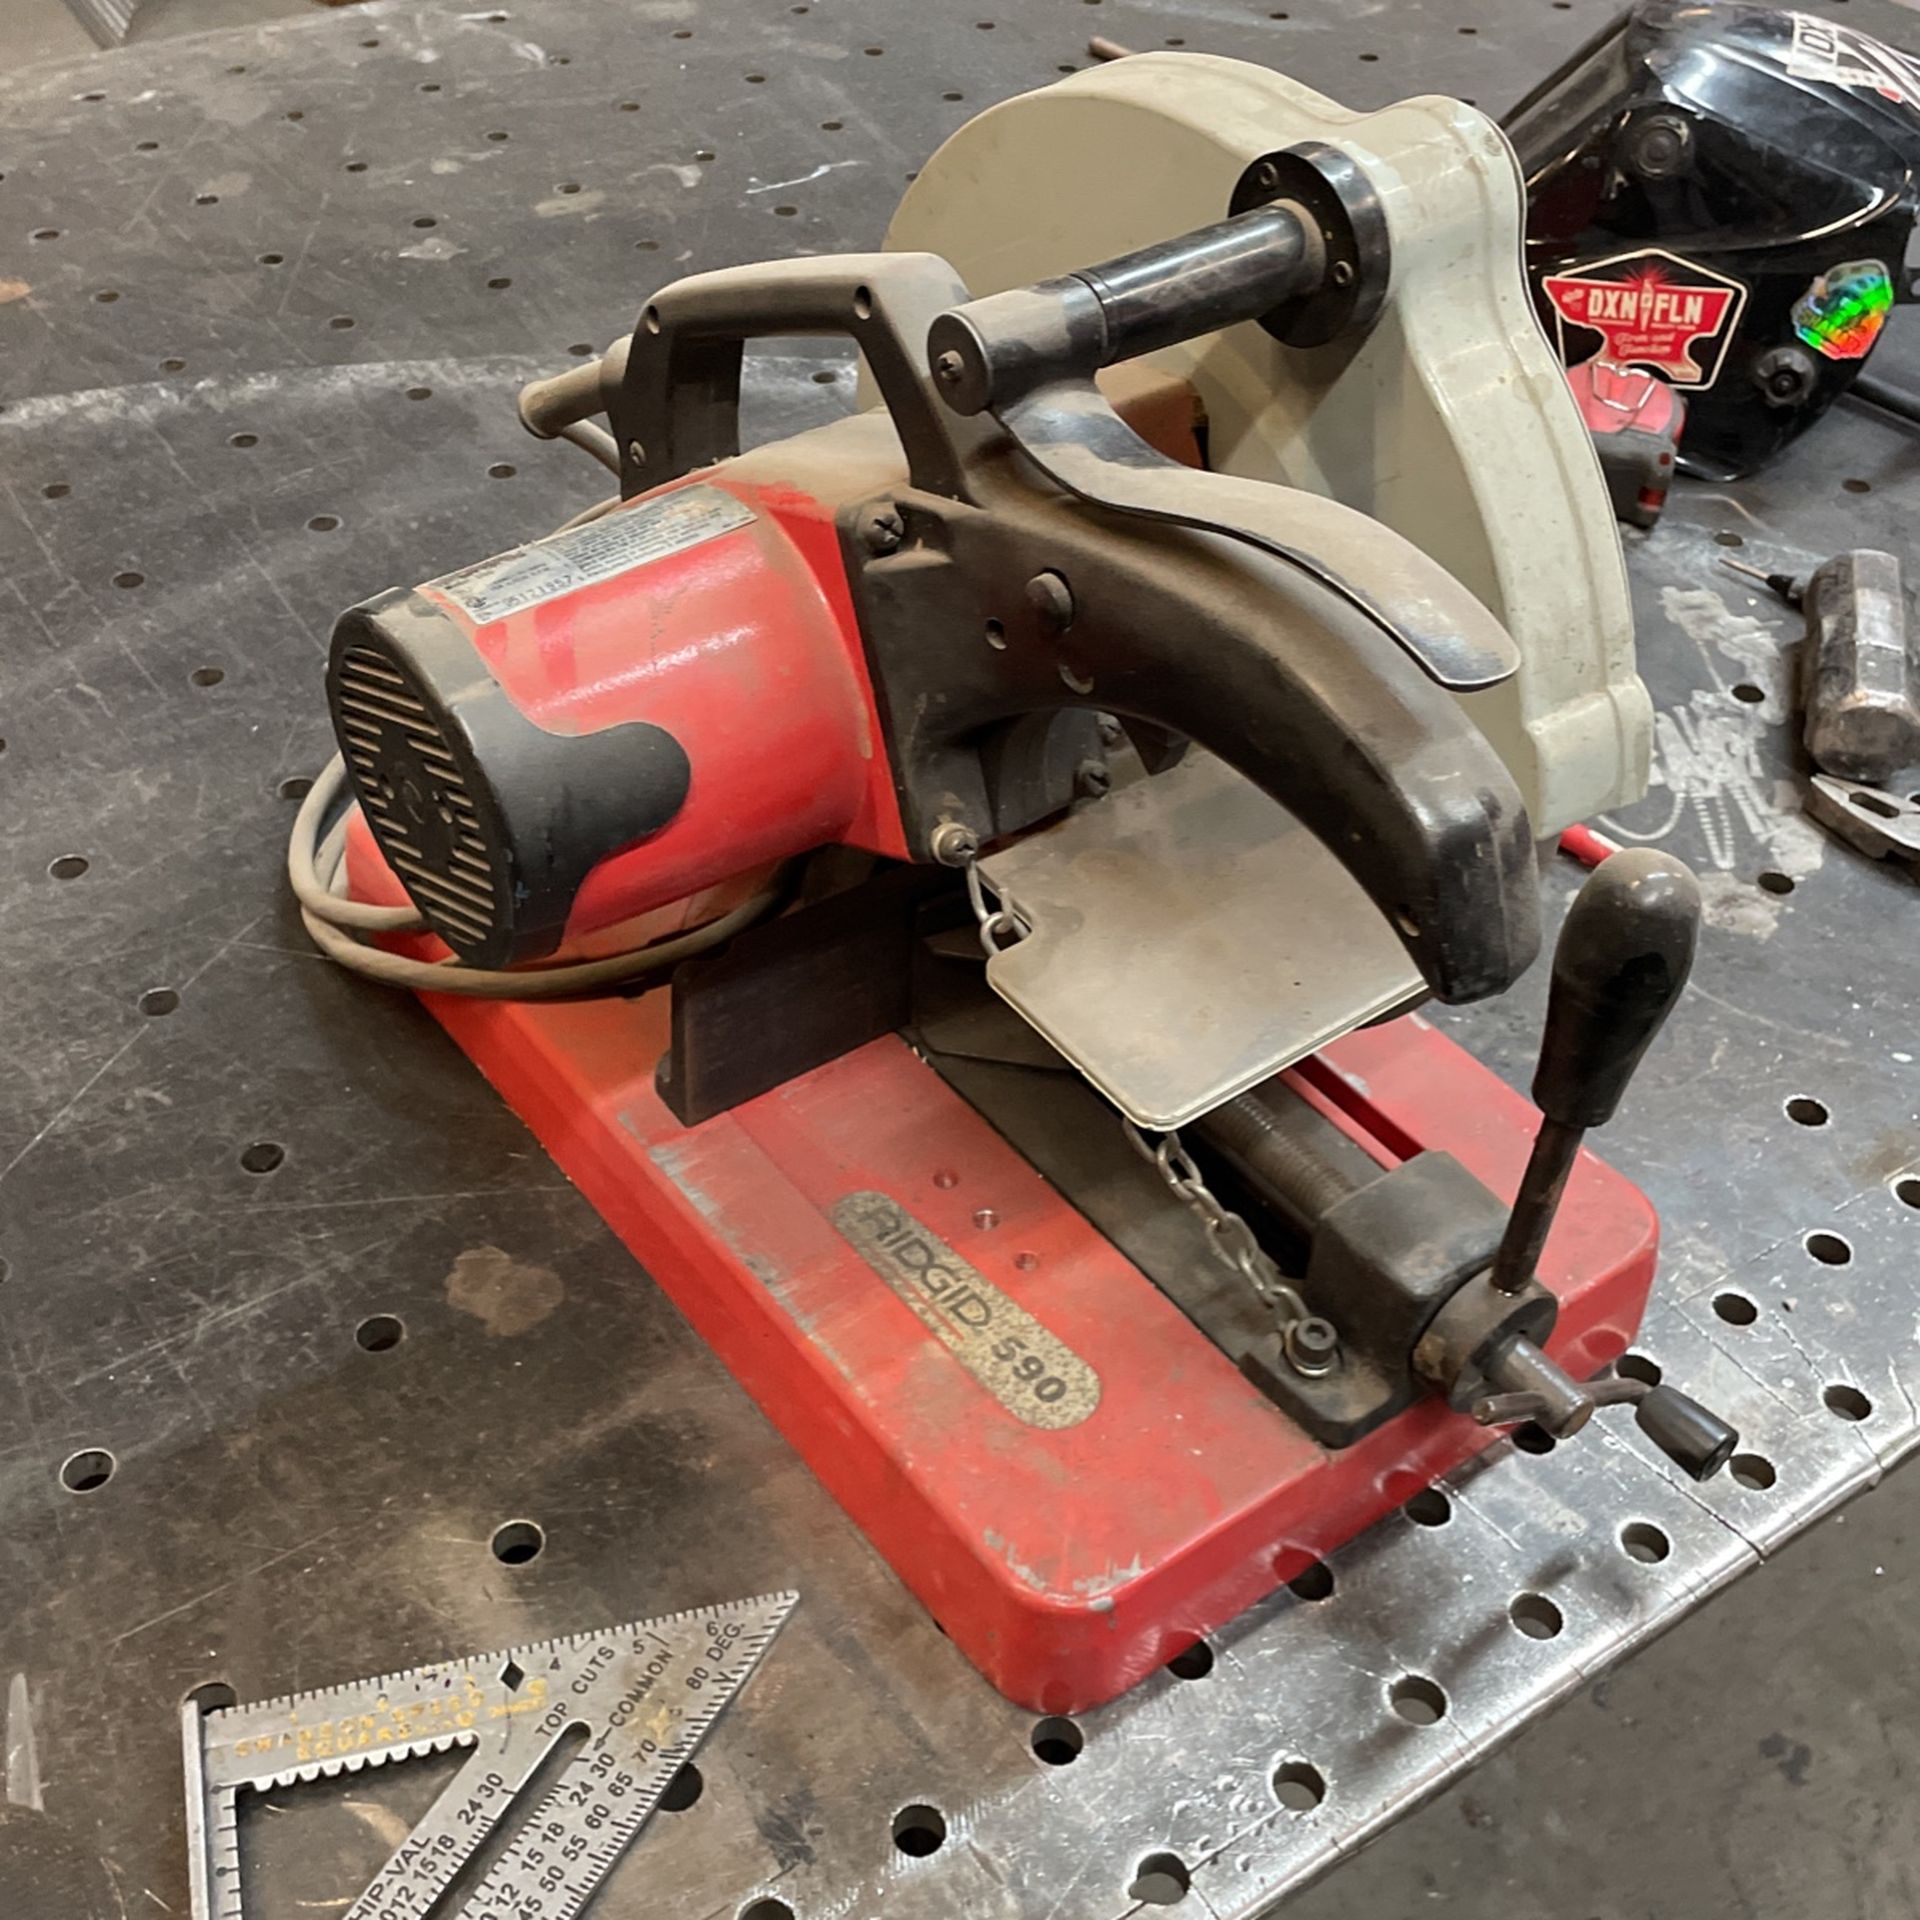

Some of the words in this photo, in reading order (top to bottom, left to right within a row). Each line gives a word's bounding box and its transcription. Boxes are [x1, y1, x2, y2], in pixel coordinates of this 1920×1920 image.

[857, 1205, 994, 1328] RIDGID
[991, 1336, 1067, 1404] 590
[535, 1702, 568, 1737] TOP
[571, 1646, 615, 1695] CUTS
[608, 1649, 674, 1728] COMMON
[632, 1638, 645, 1655] 5
[706, 1621, 719, 1637] 6
[390, 1885, 416, 1909] 12
[413, 1857, 437, 1880] 15
[432, 1833, 456, 1857] 18
[457, 1798, 483, 1825] 24
[477, 1772, 503, 1799] 30
[495, 1883, 520, 1906] 12
[521, 1847, 545, 1872] 15
[541, 1821, 565, 1845] 18
[568, 1781, 594, 1807] 24
[589, 1752, 616, 1779] 30
[538, 1865, 565, 1893] 50
[561, 1834, 588, 1862] 55
[584, 1804, 611, 1830] 60
[607, 1771, 633, 1798] 65
[632, 1738, 656, 1763] 70
[686, 1666, 710, 1691] 80
